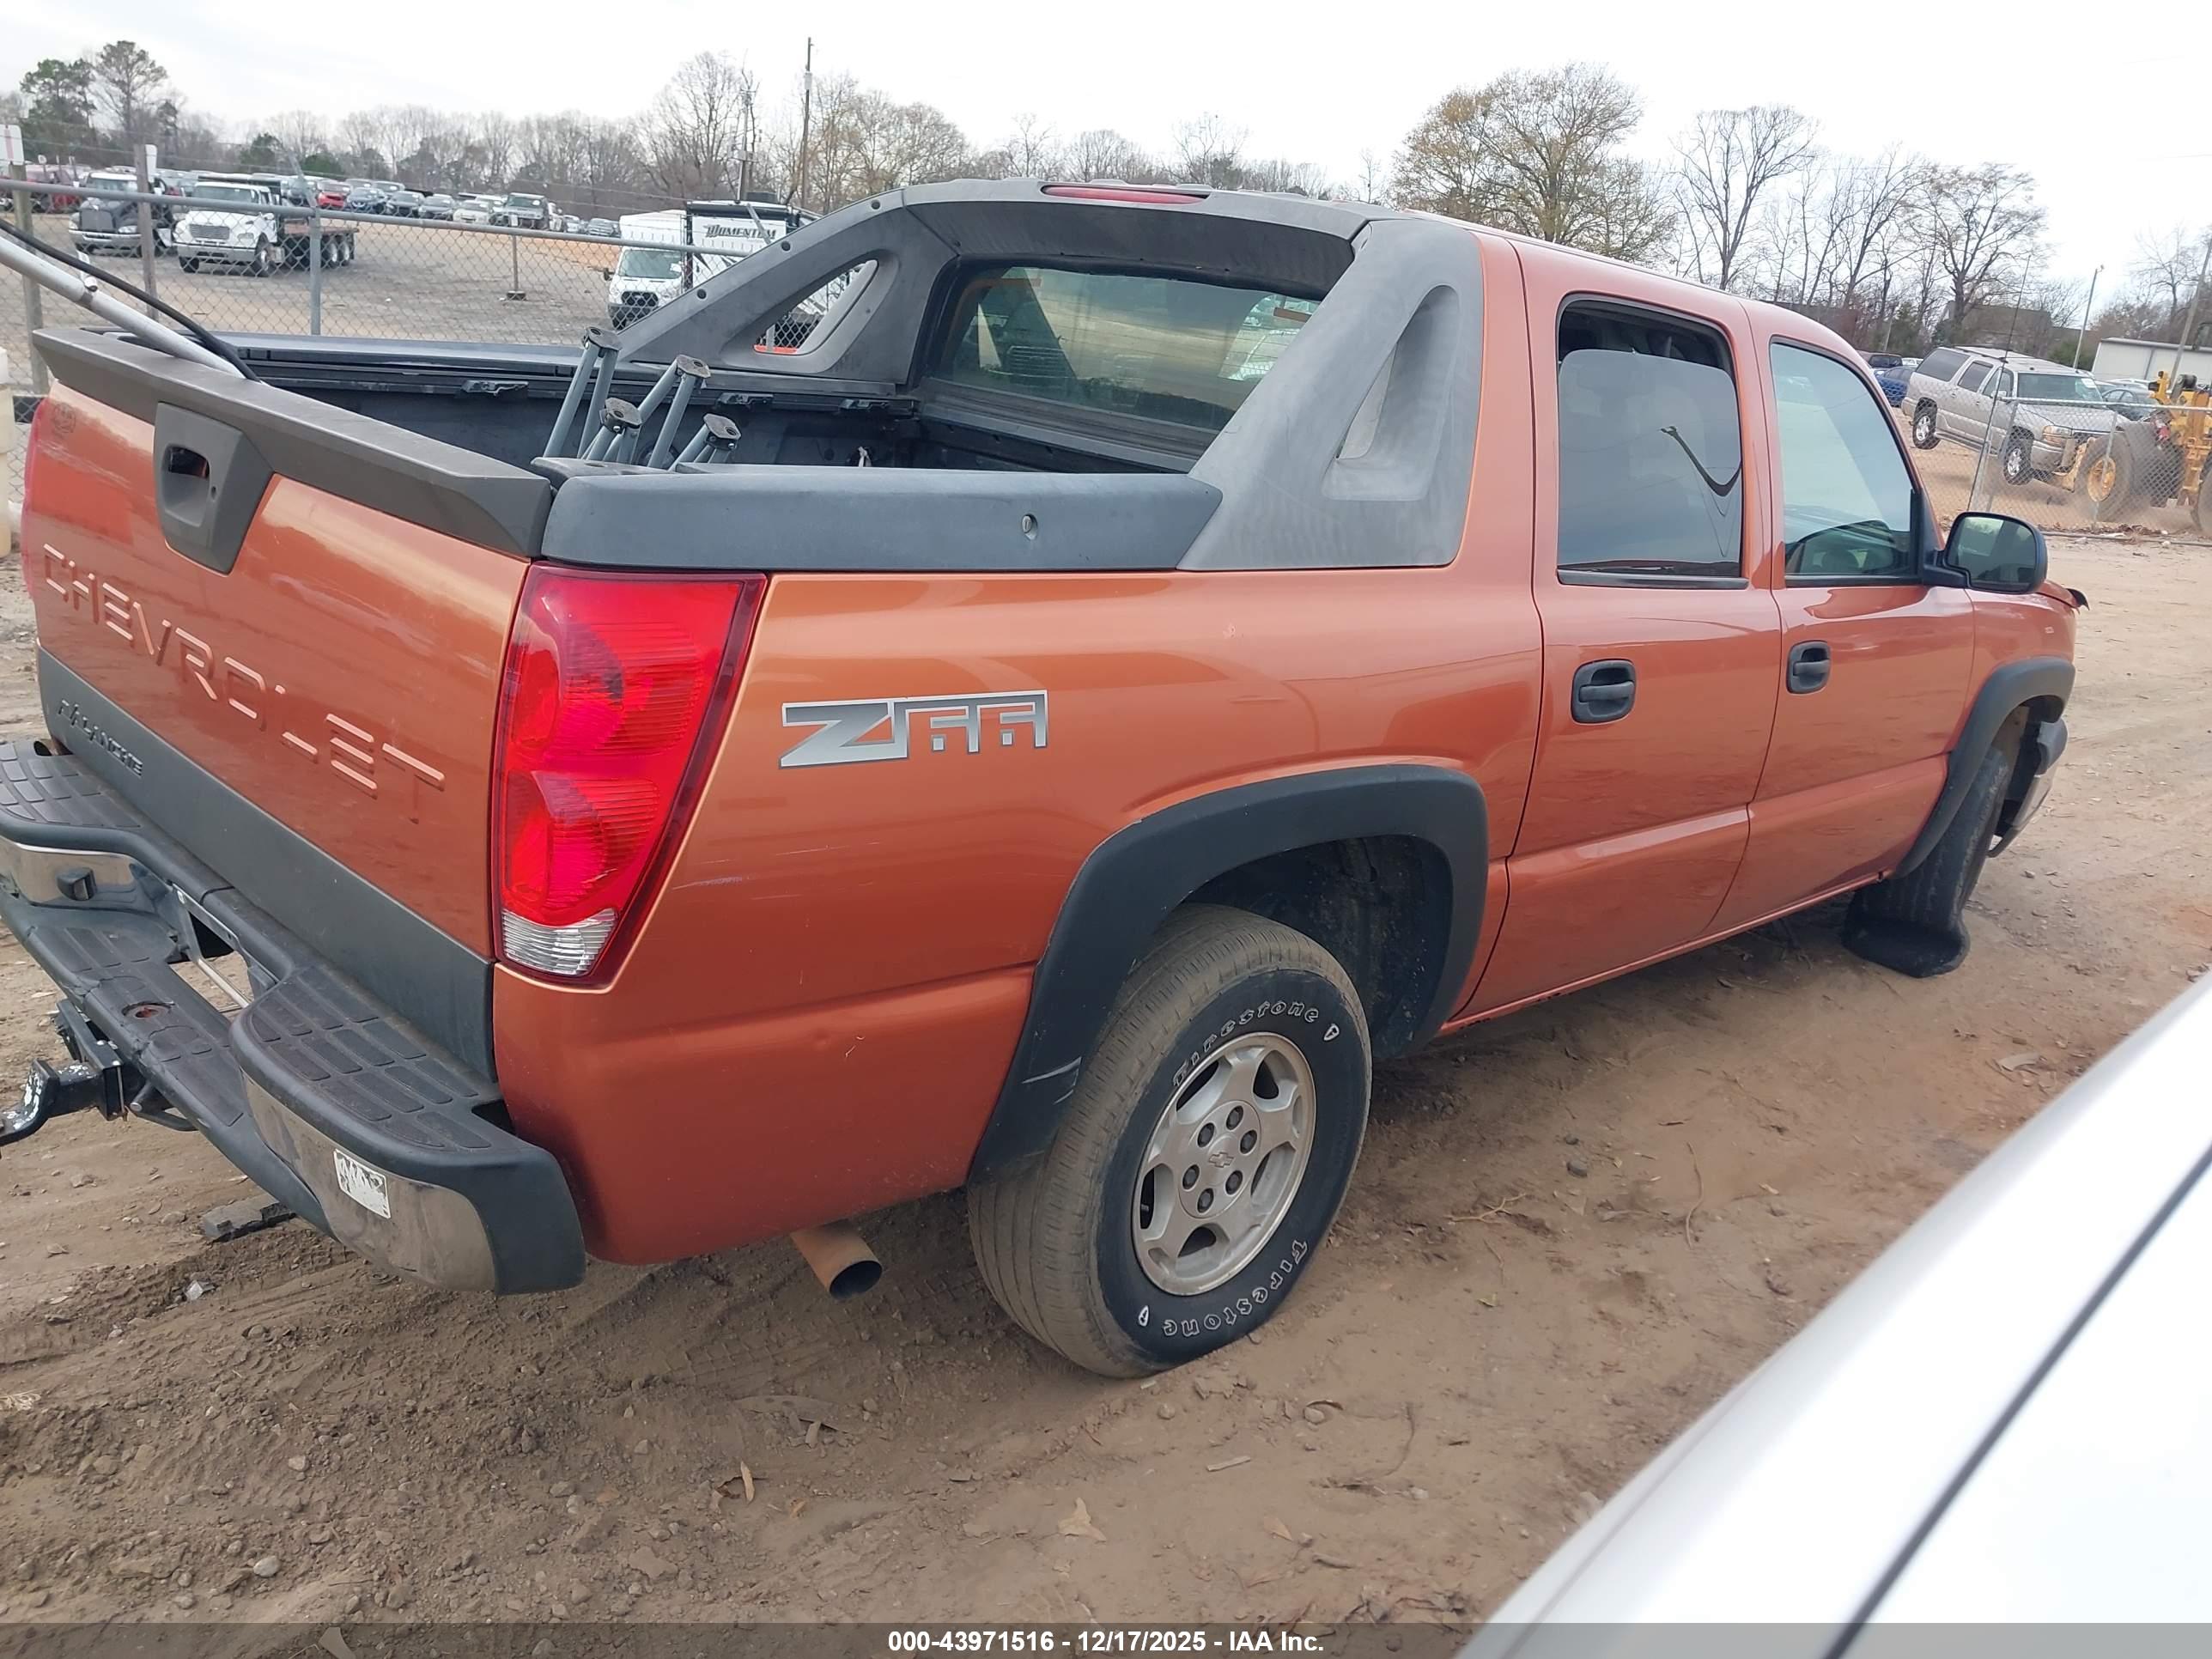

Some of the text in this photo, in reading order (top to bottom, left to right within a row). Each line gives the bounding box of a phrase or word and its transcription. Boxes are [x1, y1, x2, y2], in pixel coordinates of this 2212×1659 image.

[43, 544, 445, 824] CHEVROLET
[1173, 1000, 1320, 1087] Firestone
[1163, 1239, 1309, 1337] Firestone
